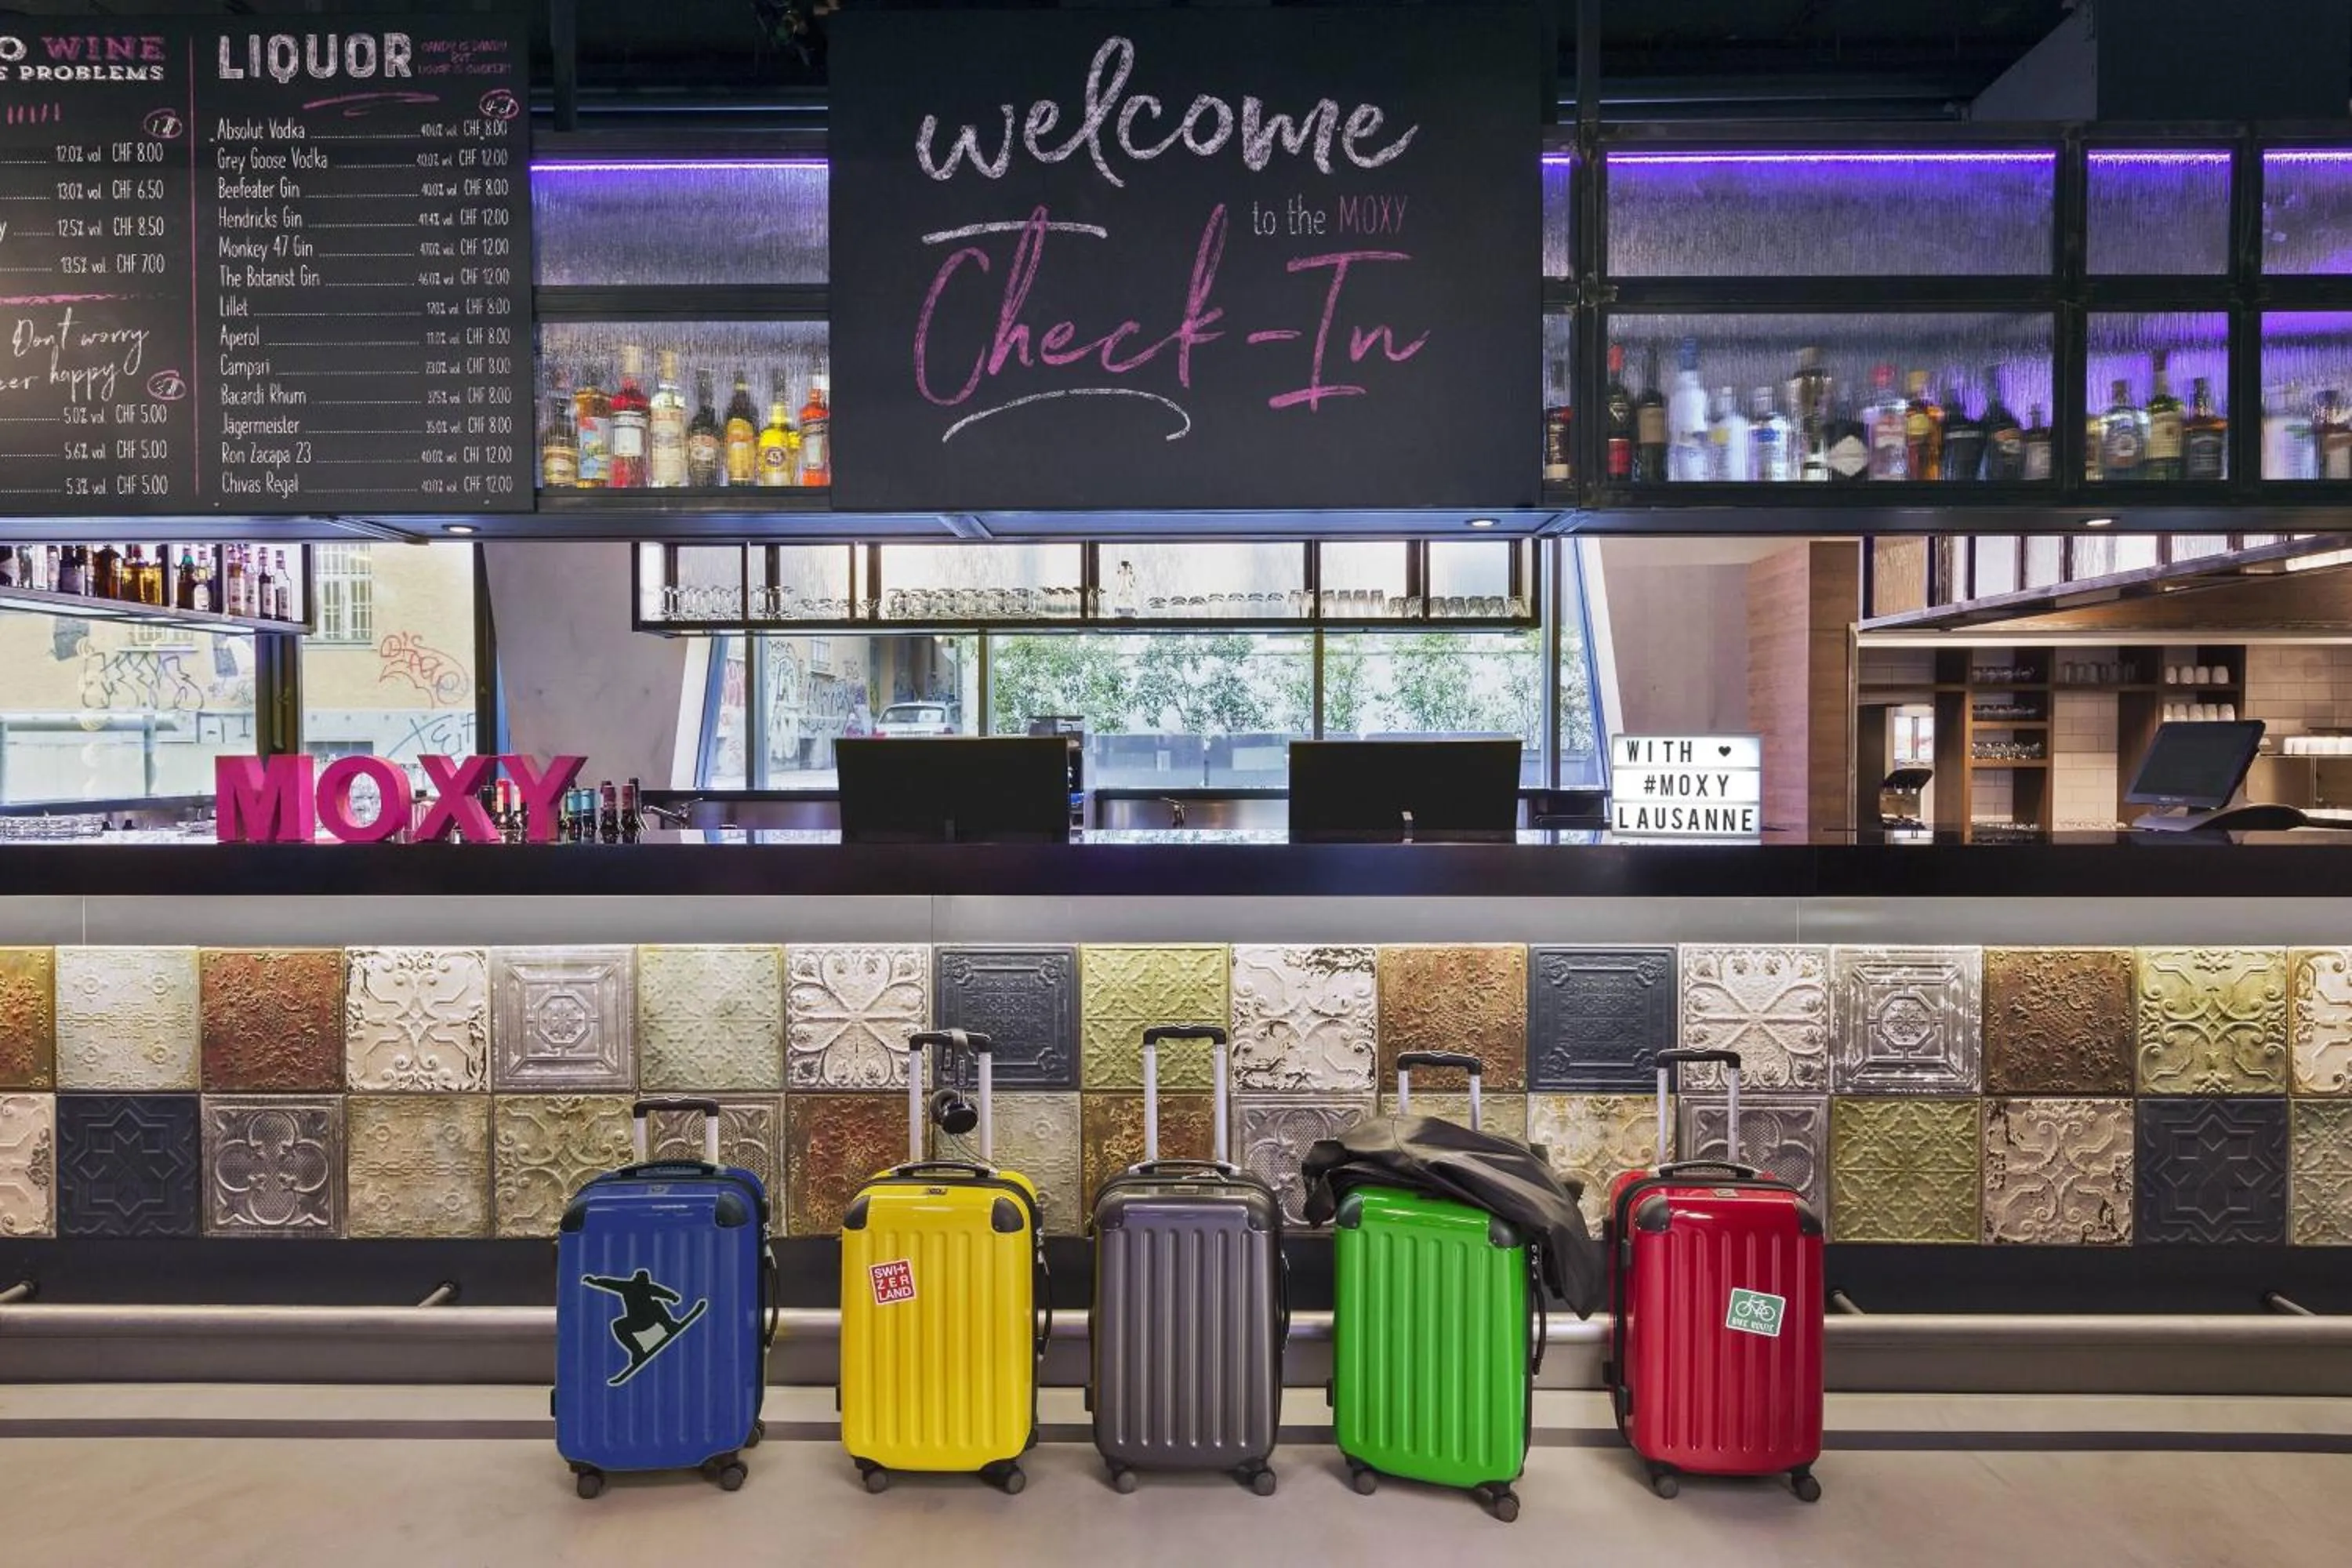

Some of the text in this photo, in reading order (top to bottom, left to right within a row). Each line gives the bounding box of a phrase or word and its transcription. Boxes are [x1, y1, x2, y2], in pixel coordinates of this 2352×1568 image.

[42, 36, 165, 60] WINE
[219, 33, 412, 83] LIQUOR
[20, 65, 164, 81] PROBLEMS
[916, 37, 1418, 187] welcome
[217, 117, 264, 140] Absolut
[268, 117, 305, 140] Vodka
[463, 119, 481, 136] CHF
[111, 141, 133, 162] CHF
[136, 141, 164, 162] 8.00
[217, 147, 246, 174] Grey
[251, 147, 286, 169] Goose
[291, 146, 328, 169] Vodka
[459, 148, 477, 166] CHF
[111, 180, 133, 200] CHF
[136, 179, 164, 200] 6.50
[218, 176, 275, 198] Beefeater
[279, 176, 301, 198] Gin
[464, 178, 482, 196] CHF
[219, 205, 278, 228] Hendricks
[282, 205, 303, 227] Gin
[460, 208, 477, 226] CHF
[1252, 193, 1408, 235] to the MOXY
[113, 216, 133, 236] CHF
[137, 216, 164, 236] 8.50
[219, 235, 268, 263] Monkey
[272, 234, 289, 258] 47
[292, 234, 313, 258] Gin
[460, 238, 478, 256] CHF
[117, 253, 137, 274] CHF
[220, 264, 242, 287] The
[247, 264, 296, 287] Botanist
[300, 264, 321, 286] Gin
[460, 267, 479, 285] CHF
[220, 295, 249, 318] Lillet
[466, 297, 484, 314] CHF
[914, 205, 1430, 413] Check-In
[220, 324, 260, 351] Aperol
[466, 327, 484, 345] CHF
[81, 329, 150, 376] worry
[49, 344, 122, 403] happy
[220, 353, 270, 381] Campari
[466, 357, 485, 374] CHF
[220, 383, 264, 405] Bacardi
[269, 383, 307, 405] Rhum
[468, 387, 485, 404] CHF
[115, 404, 137, 424] CHF
[140, 404, 168, 424] 5.00
[220, 412, 300, 439] Jägermeister
[468, 416, 485, 434] CHF
[117, 439, 137, 459] CHF
[140, 439, 168, 459] 5.00
[222, 441, 245, 463] Ron
[250, 441, 291, 470] Zacapa
[296, 441, 312, 463] 23
[117, 474, 137, 495] CHF
[141, 474, 169, 495] 5.00
[222, 471, 262, 494] Chivas
[266, 470, 299, 499] Regal
[463, 475, 482, 493] CHF
[1626, 740, 1693, 763] WITH
[1643, 774, 1730, 797] #MOXY
[215, 753, 588, 844] MOXY
[1618, 807, 1754, 832] LAUSANNE
[878, 1286, 913, 1301] LAND
